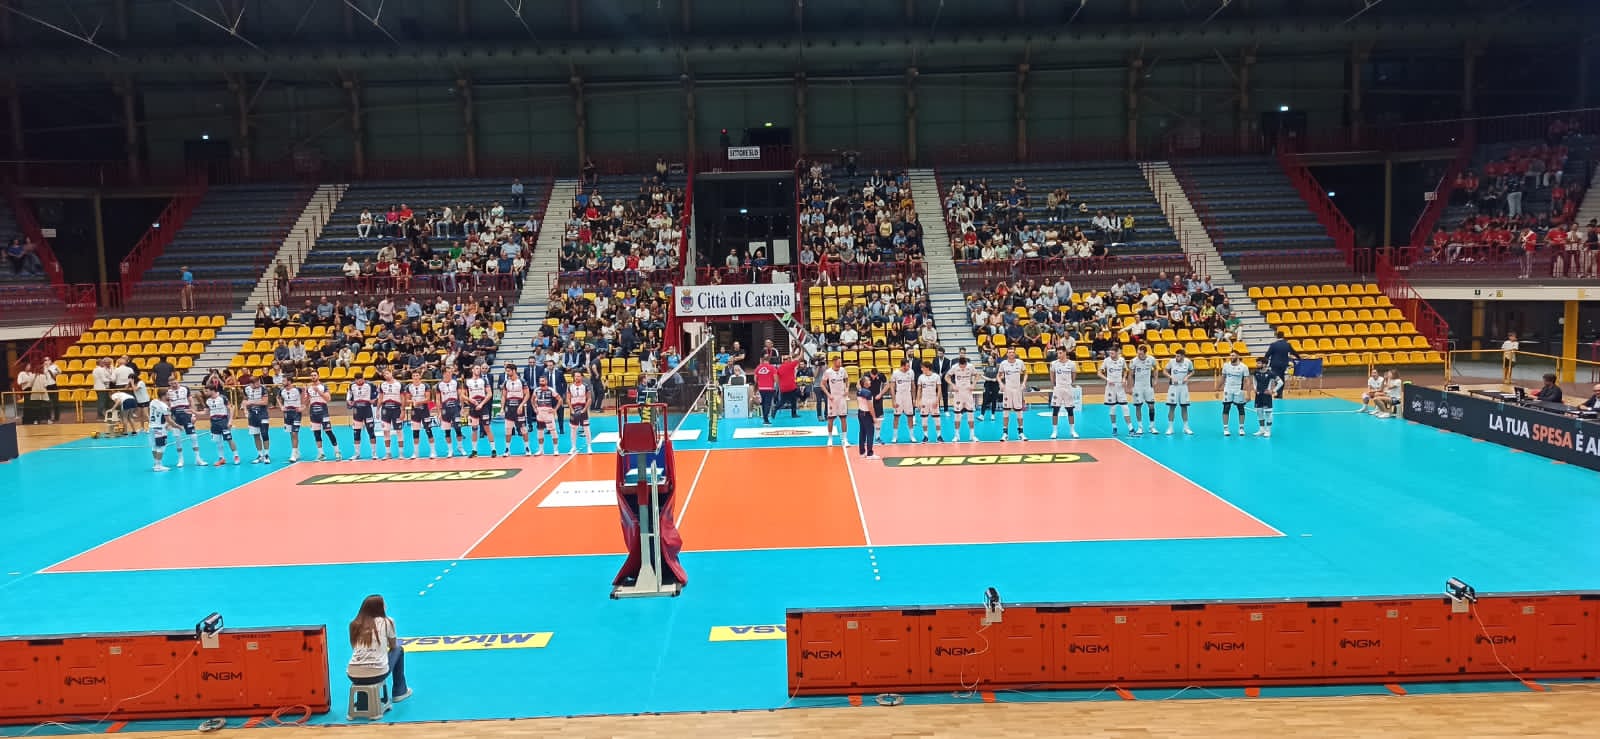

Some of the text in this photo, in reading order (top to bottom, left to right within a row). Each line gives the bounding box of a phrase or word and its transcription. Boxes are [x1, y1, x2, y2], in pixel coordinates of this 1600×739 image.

[697, 289, 791, 309] Città di Catania
[1489, 413, 1504, 432] LA
[1505, 416, 1530, 440] TUA
[1531, 423, 1573, 449] SPESA
[1575, 430, 1584, 452] È
[897, 453, 1082, 466] CREDEM
[311, 469, 510, 484] CREDEM
[1075, 643, 1110, 654] NGM
[1209, 641, 1245, 651] NGM
[1346, 638, 1381, 648] NGM
[807, 649, 842, 660] NGM
[941, 646, 976, 656] NGM
[71, 676, 106, 685] NGM
[206, 671, 243, 681] NGM
